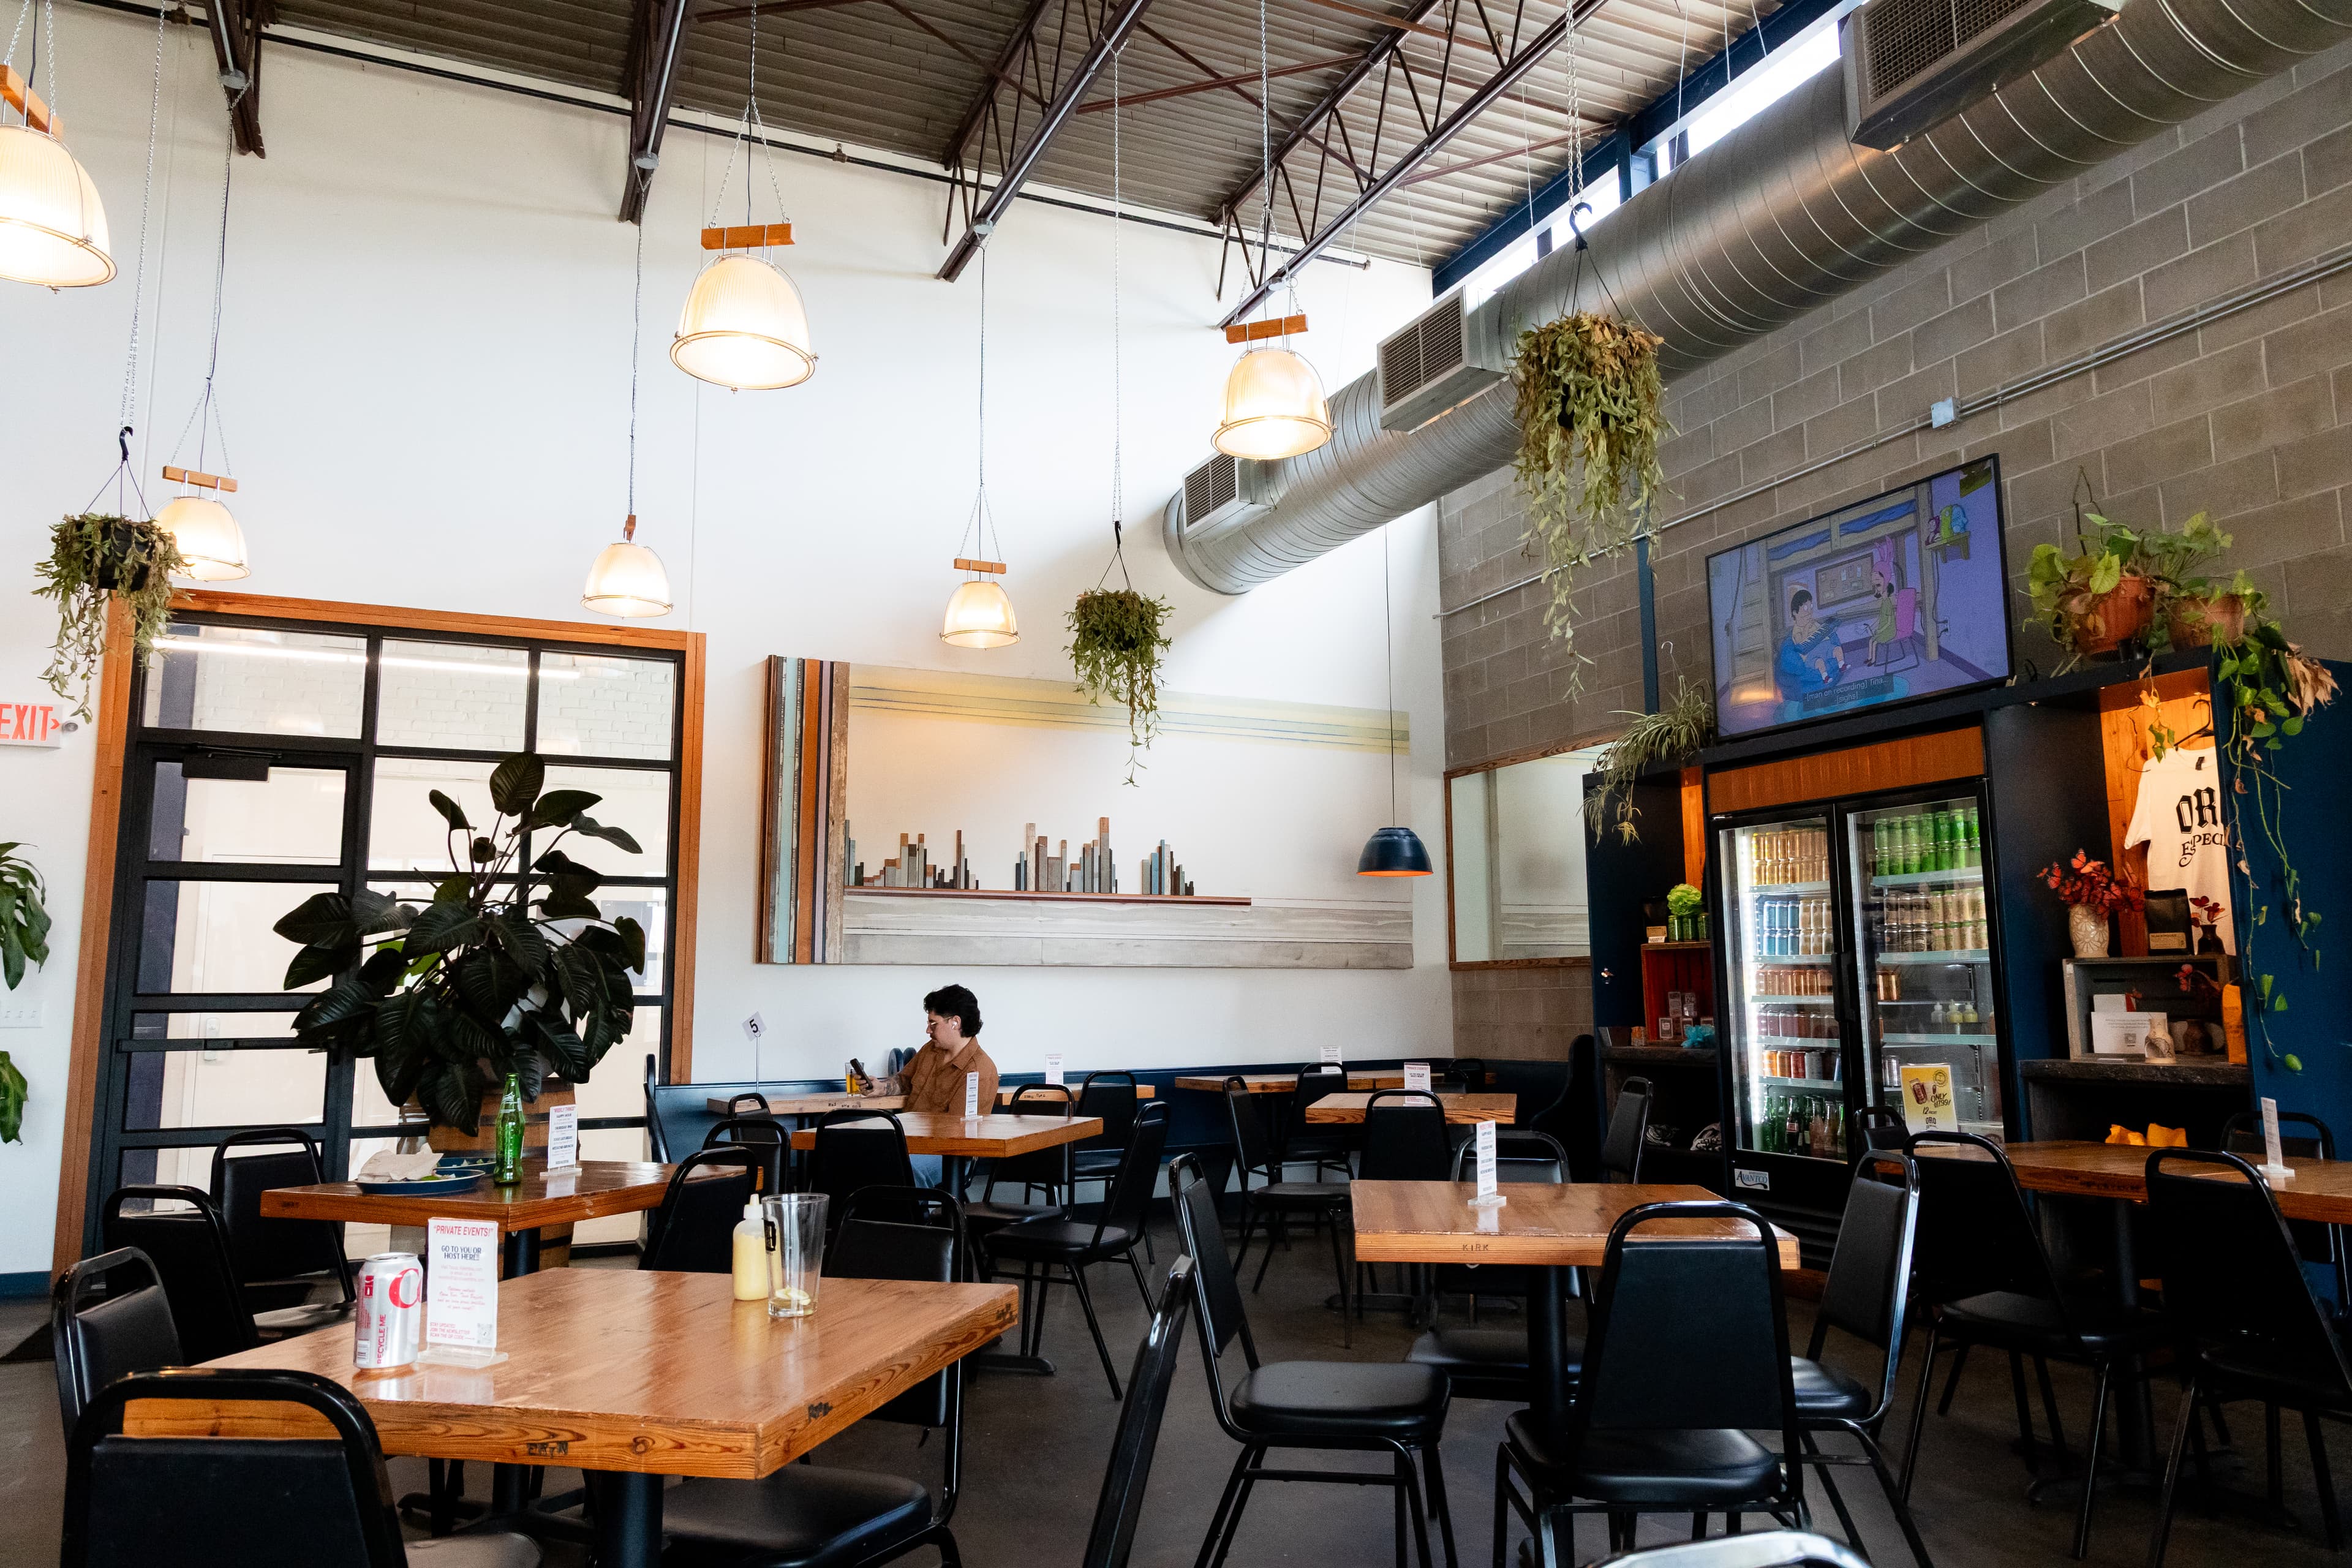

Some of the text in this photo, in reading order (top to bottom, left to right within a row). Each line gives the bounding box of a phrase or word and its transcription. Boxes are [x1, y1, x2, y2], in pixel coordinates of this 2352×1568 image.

[1833, 681, 1868, 694] recording]
[0, 704, 53, 741] EXIT
[2179, 833, 2225, 867] ESPECI
[749, 1019, 759, 1033] 5
[1931, 1093, 1947, 1103] ONLY
[1736, 1171, 1768, 1187] AVANTCO
[377, 1314, 386, 1364] RECYCLE ME
